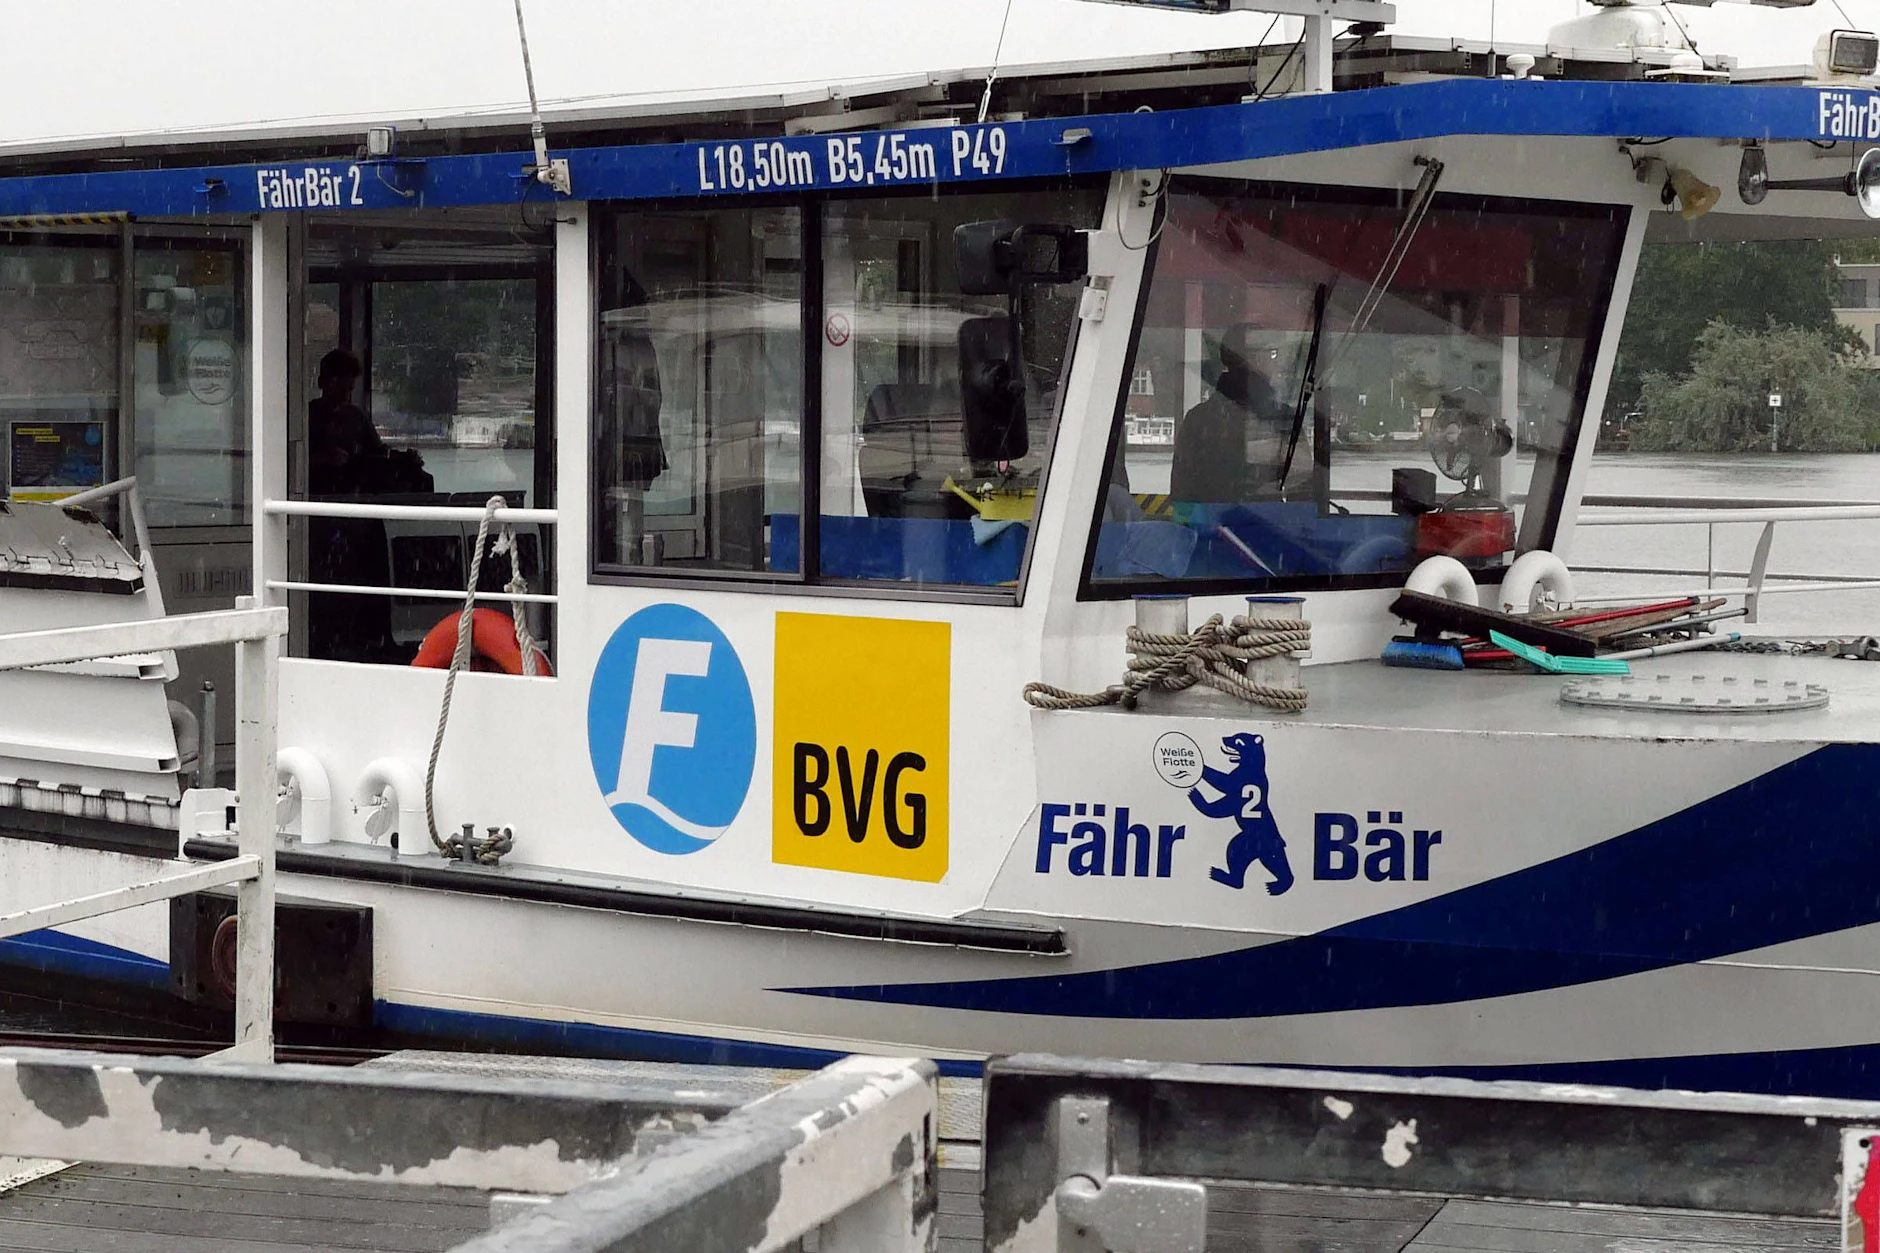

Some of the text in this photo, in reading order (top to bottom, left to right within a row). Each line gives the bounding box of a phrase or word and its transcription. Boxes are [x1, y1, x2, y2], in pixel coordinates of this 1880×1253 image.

[698, 127, 1006, 191] L18,50m B5,45m P49
[257, 165, 363, 208] FährBär 2
[616, 638, 712, 797] F
[1161, 747, 1194, 757] Weiße
[1163, 757, 1195, 767] Flotte
[794, 742, 926, 849] BVG
[1241, 784, 1262, 818] 2
[1035, 803, 1442, 881] Fähr Bär
